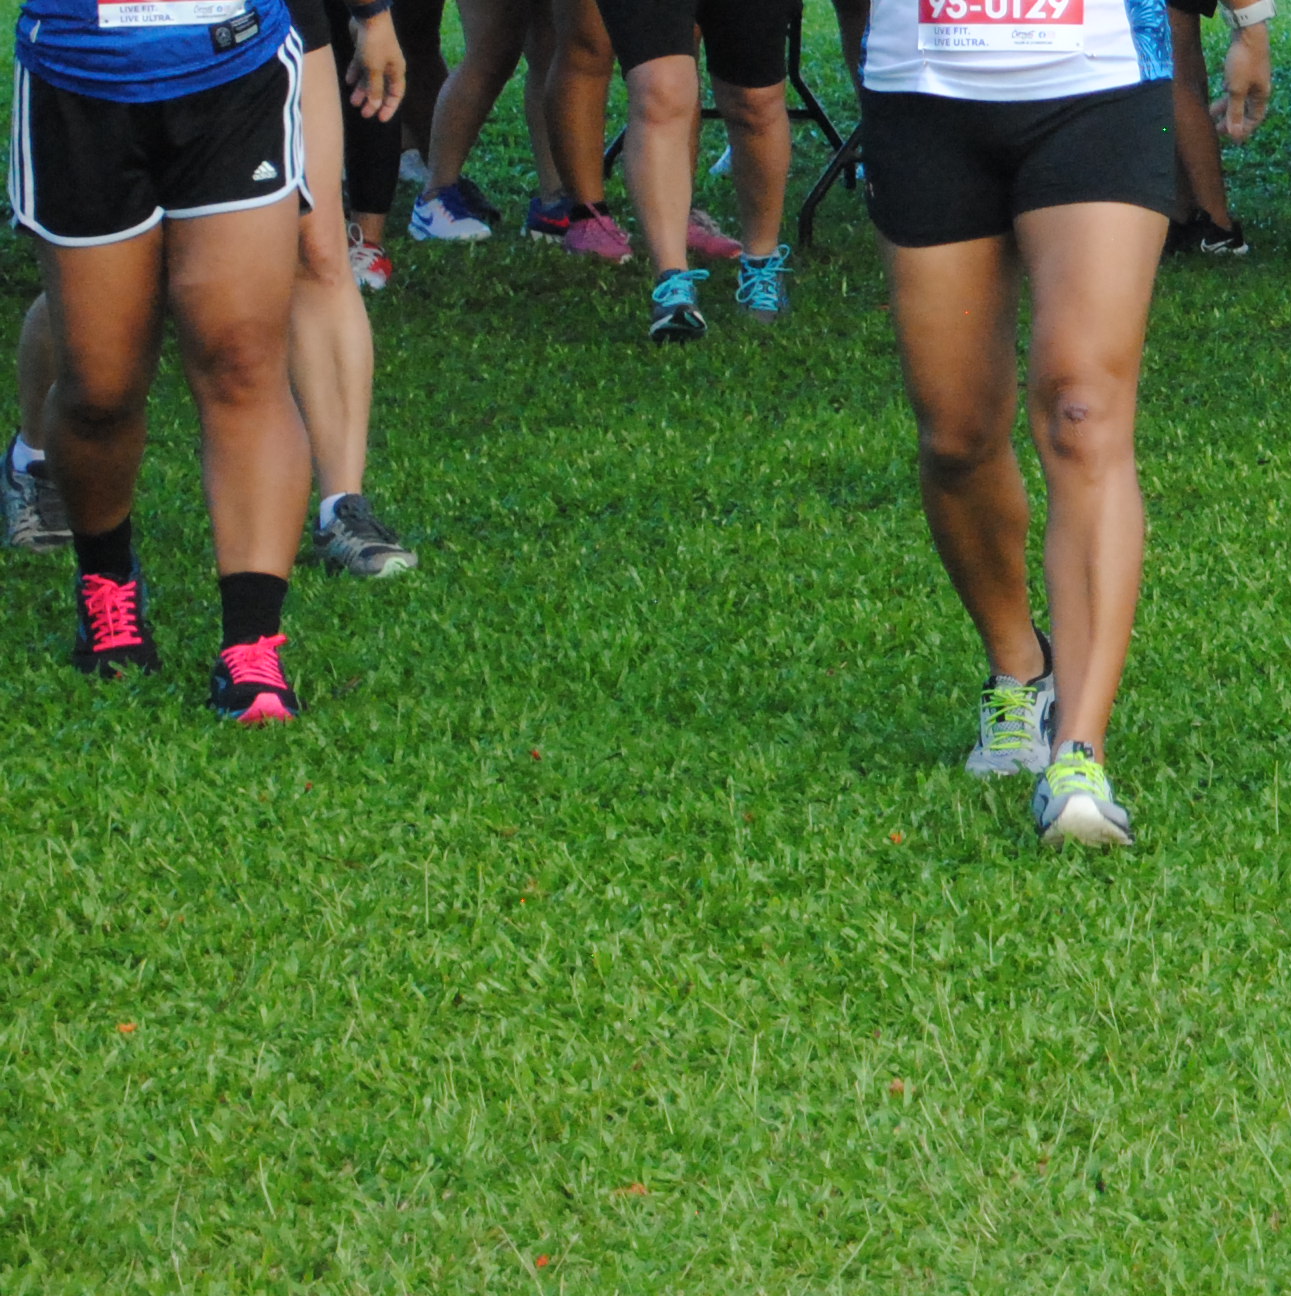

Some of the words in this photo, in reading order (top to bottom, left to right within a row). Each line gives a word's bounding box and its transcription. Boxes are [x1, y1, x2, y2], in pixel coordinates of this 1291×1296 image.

[119, 5, 140, 14] LIVE
[120, 15, 140, 24] LIVE
[142, 14, 174, 23] ULTRA.
[934, 26, 951, 36] LIVE
[953, 26, 971, 36] FIT.
[934, 37, 951, 47] LIVE
[953, 37, 989, 47] ULTRA.
